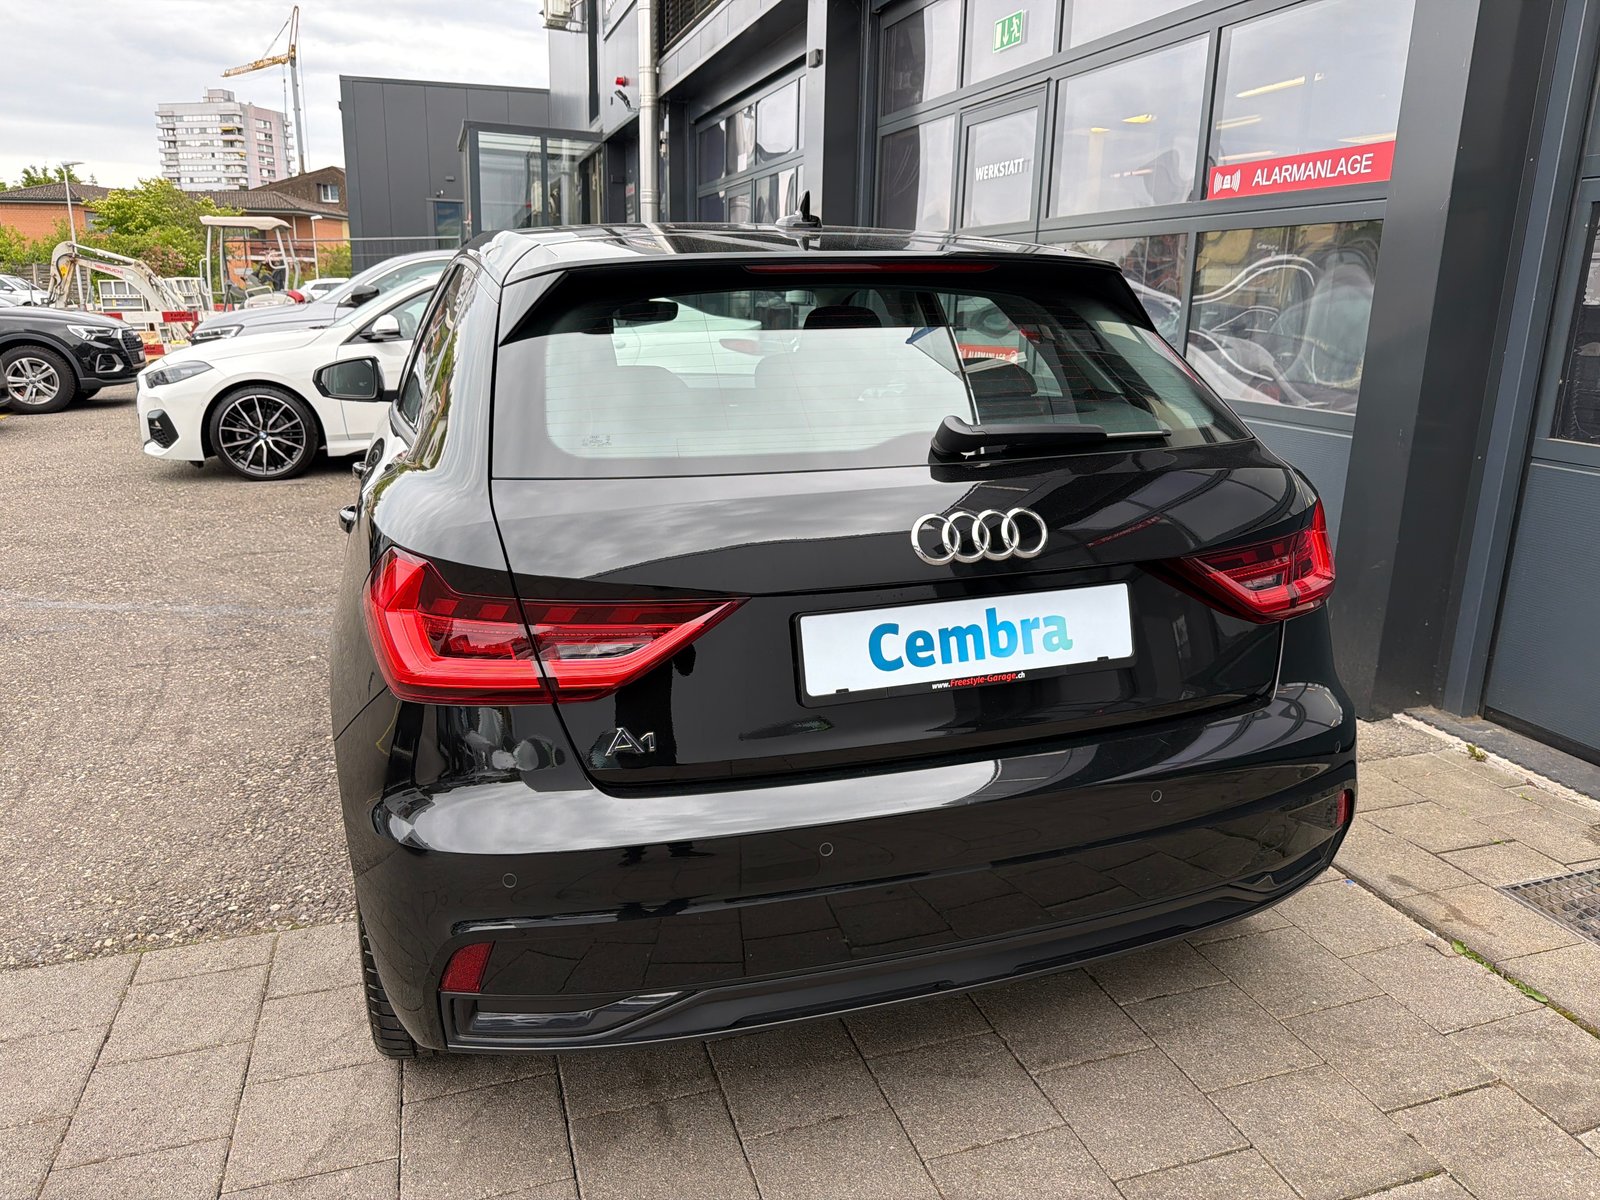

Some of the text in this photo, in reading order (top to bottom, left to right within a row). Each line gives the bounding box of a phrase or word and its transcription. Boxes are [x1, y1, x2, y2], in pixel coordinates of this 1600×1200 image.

[975, 157, 1025, 181] WERKSTATT
[1252, 153, 1374, 187] ALARMANLAGE
[868, 607, 1074, 673] Cembra
[931, 671, 1026, 690] www.Freestyle-Garage.ch
[605, 727, 656, 757] A1
